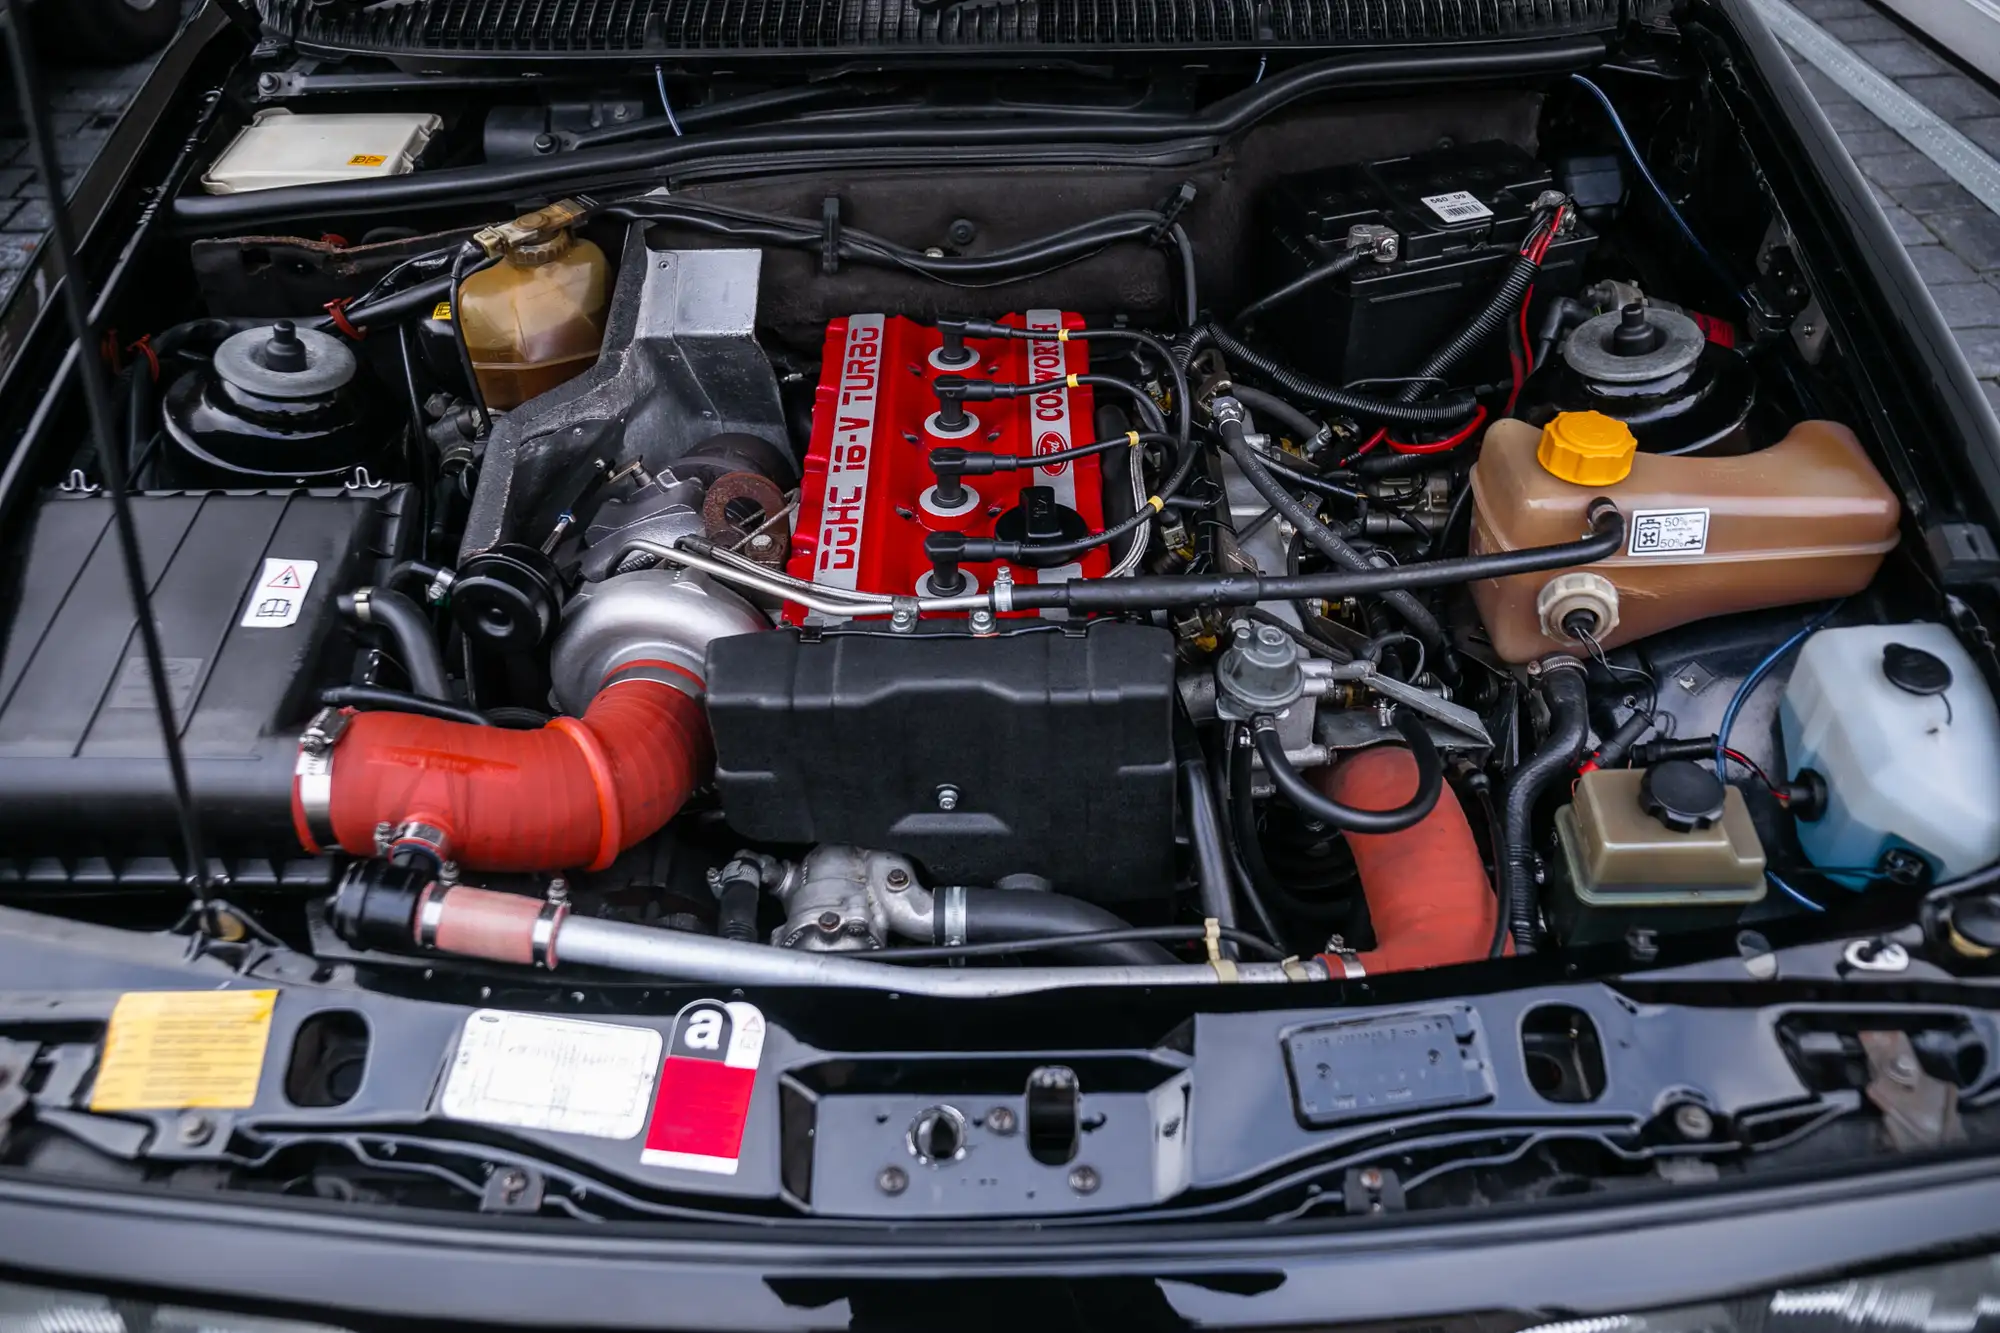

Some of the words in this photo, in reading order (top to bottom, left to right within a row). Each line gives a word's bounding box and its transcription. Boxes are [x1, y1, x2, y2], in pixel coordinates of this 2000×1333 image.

[820, 486, 862, 570] DOHC
[842, 327, 879, 405] TURBO
[1032, 323, 1064, 421] COWORH
